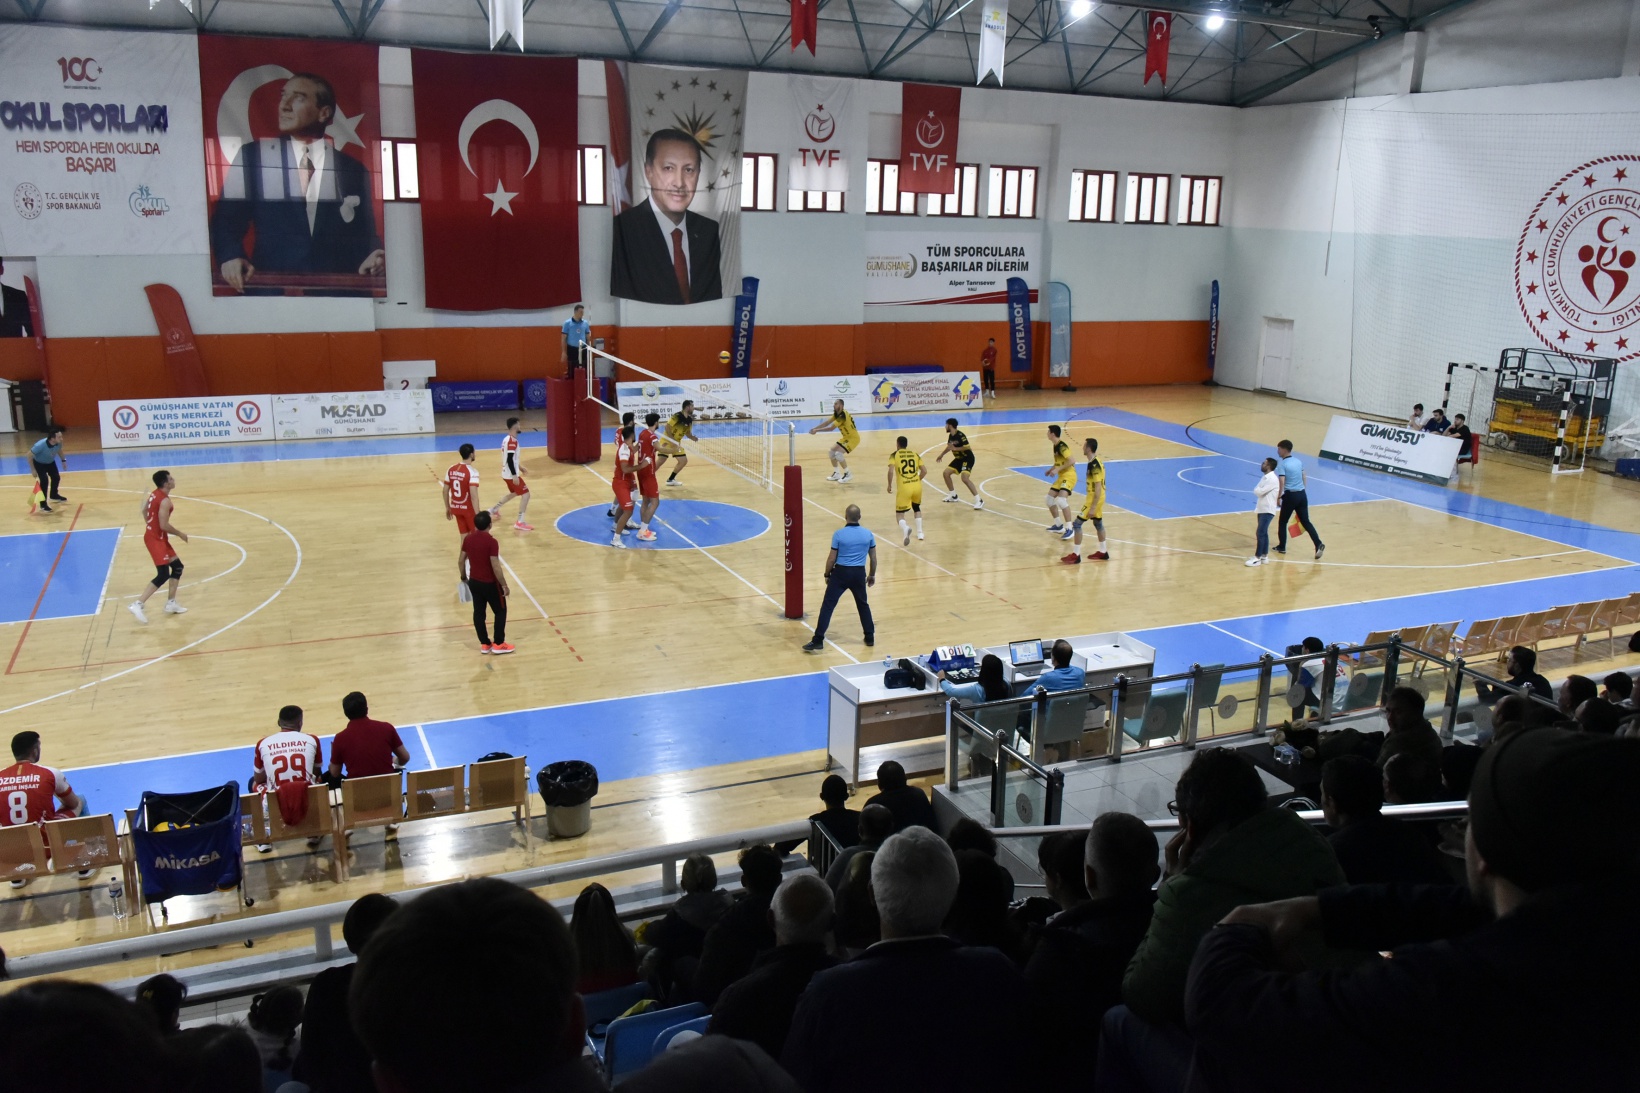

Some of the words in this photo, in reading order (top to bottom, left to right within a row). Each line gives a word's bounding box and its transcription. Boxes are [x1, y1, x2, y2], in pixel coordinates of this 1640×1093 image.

[0, 101, 62, 131] OKUL
[62, 102, 168, 133] SPORLARI
[16, 140, 41, 153] HEM
[44, 141, 88, 154] SPORDA
[90, 142, 114, 154] HEM
[116, 142, 160, 155] OKULDA
[798, 148, 840, 168] TVF
[909, 153, 949, 173] TVF
[66, 157, 116, 175] BAŞARI
[45, 192, 58, 200] T.C.
[60, 191, 89, 201] GENÇLİK
[66, 202, 101, 210] BAKANLIĞI
[1547, 197, 1596, 277] CUMHURİYETİ
[927, 244, 950, 257] TÜM
[954, 246, 1025, 257] SPORCULARA
[866, 261, 910, 272] GÜMÜŞHANE
[921, 261, 983, 275] BAŞARILAR
[986, 259, 1029, 272] DİLERİM
[1548, 279, 1581, 323] TÜRKİYE
[736, 304, 751, 368] VOLEYBOL
[874, 395, 900, 403] final
[955, 392, 979, 400] final
[140, 403, 200, 412] GÜMÜŞHANE
[203, 401, 234, 409] VATAN
[153, 413, 179, 421] KURS
[181, 410, 223, 419] MERKEZİ
[334, 417, 376, 425] GÜMÜŞHANE
[146, 422, 167, 430] TÜM
[169, 421, 231, 430] SPORCULARA
[237, 426, 262, 434] Vatan
[148, 432, 200, 440] BAŞARILAR
[204, 429, 231, 437] DİLER
[1360, 423, 1420, 446] GÜMÜŞSU
[900, 459, 916, 475] 29
[453, 479, 461, 497] 9
[965, 645, 973, 656] 2
[267, 741, 307, 750] YILDIRAY
[272, 753, 307, 787] 29
[0, 785, 17, 793] ARBİR
[18, 783, 39, 791] İNŞAAT
[8, 791, 28, 824] 8
